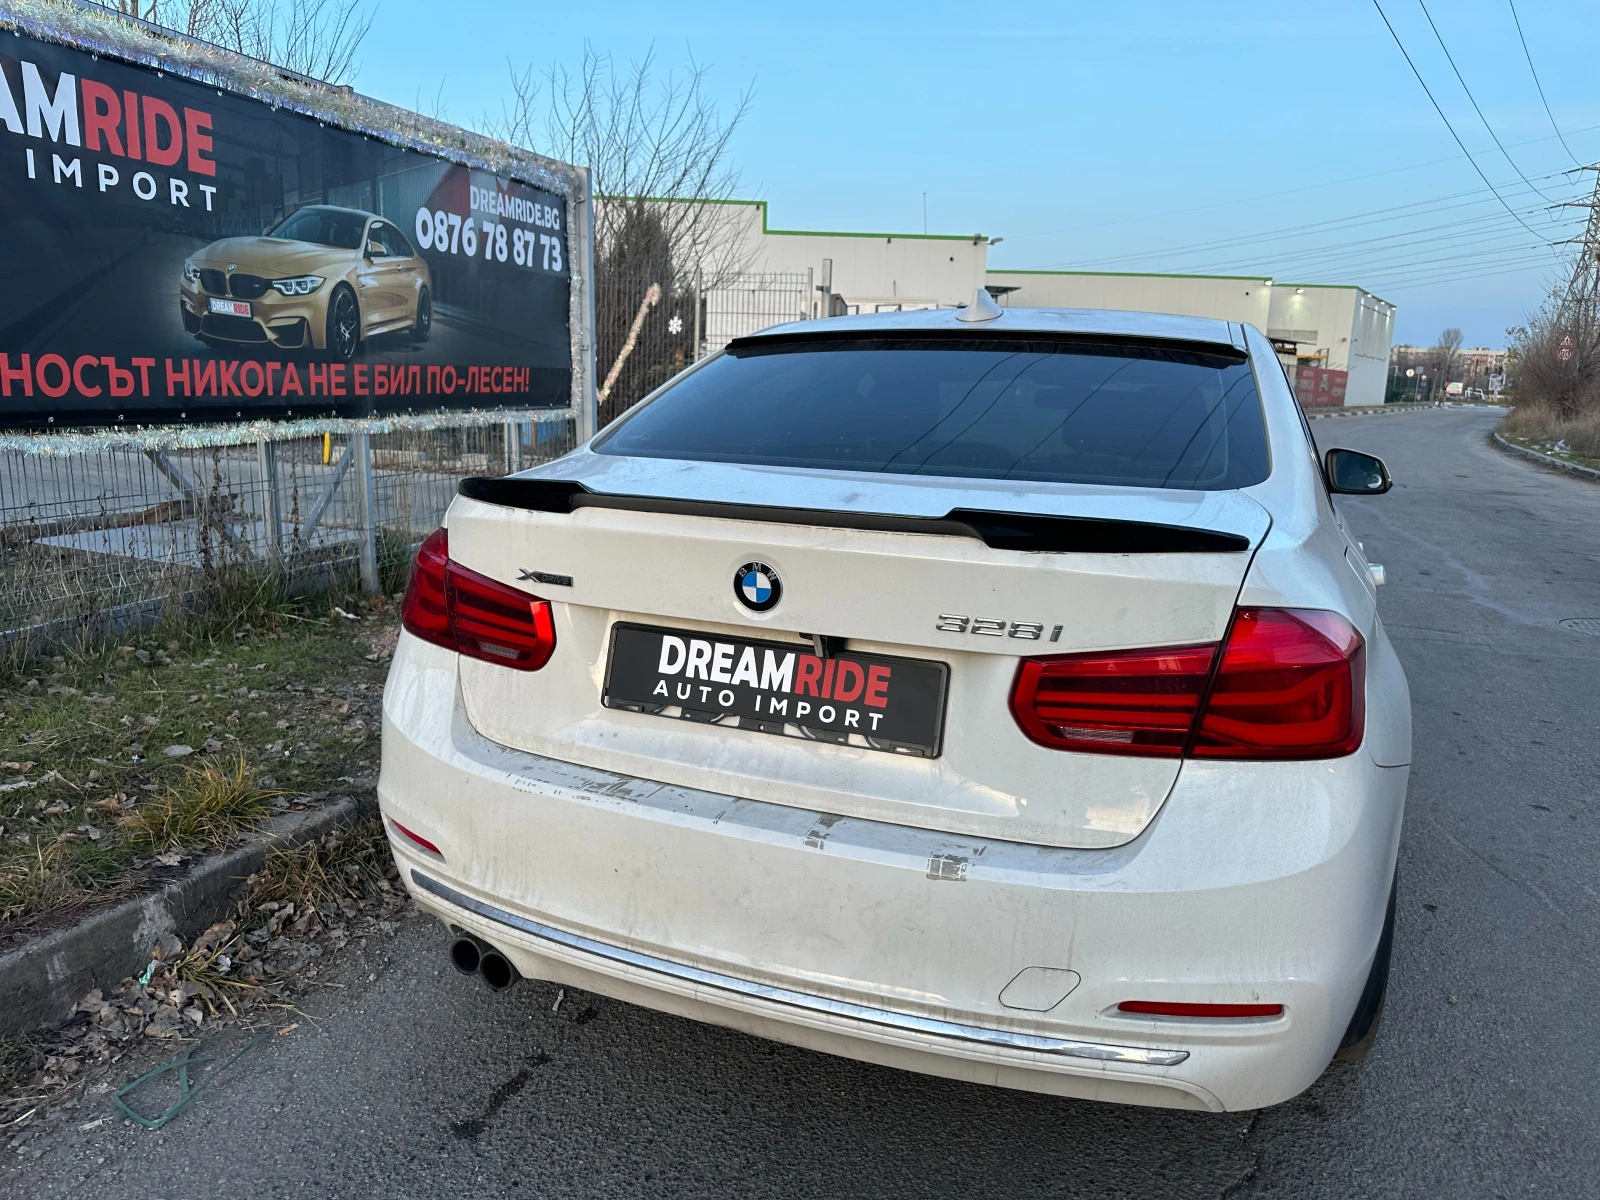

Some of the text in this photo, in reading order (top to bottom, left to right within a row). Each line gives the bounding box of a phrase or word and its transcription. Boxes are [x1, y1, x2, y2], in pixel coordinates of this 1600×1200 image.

[26, 148, 217, 212] IMPORT
[470, 185, 560, 231] DREAMRIDE.BG
[415, 206, 563, 272] 0876 78 87 73
[211, 300, 250, 315] DREAMRIDE
[0, 353, 530, 398] НОСЪТ НИКОГА НЕ Е БИЛ ПО-ЛЕСЕН!
[737, 562, 778, 581] BMW
[657, 634, 892, 709] DREAMRIDE
[652, 679, 884, 731] AUTO IMPORT
